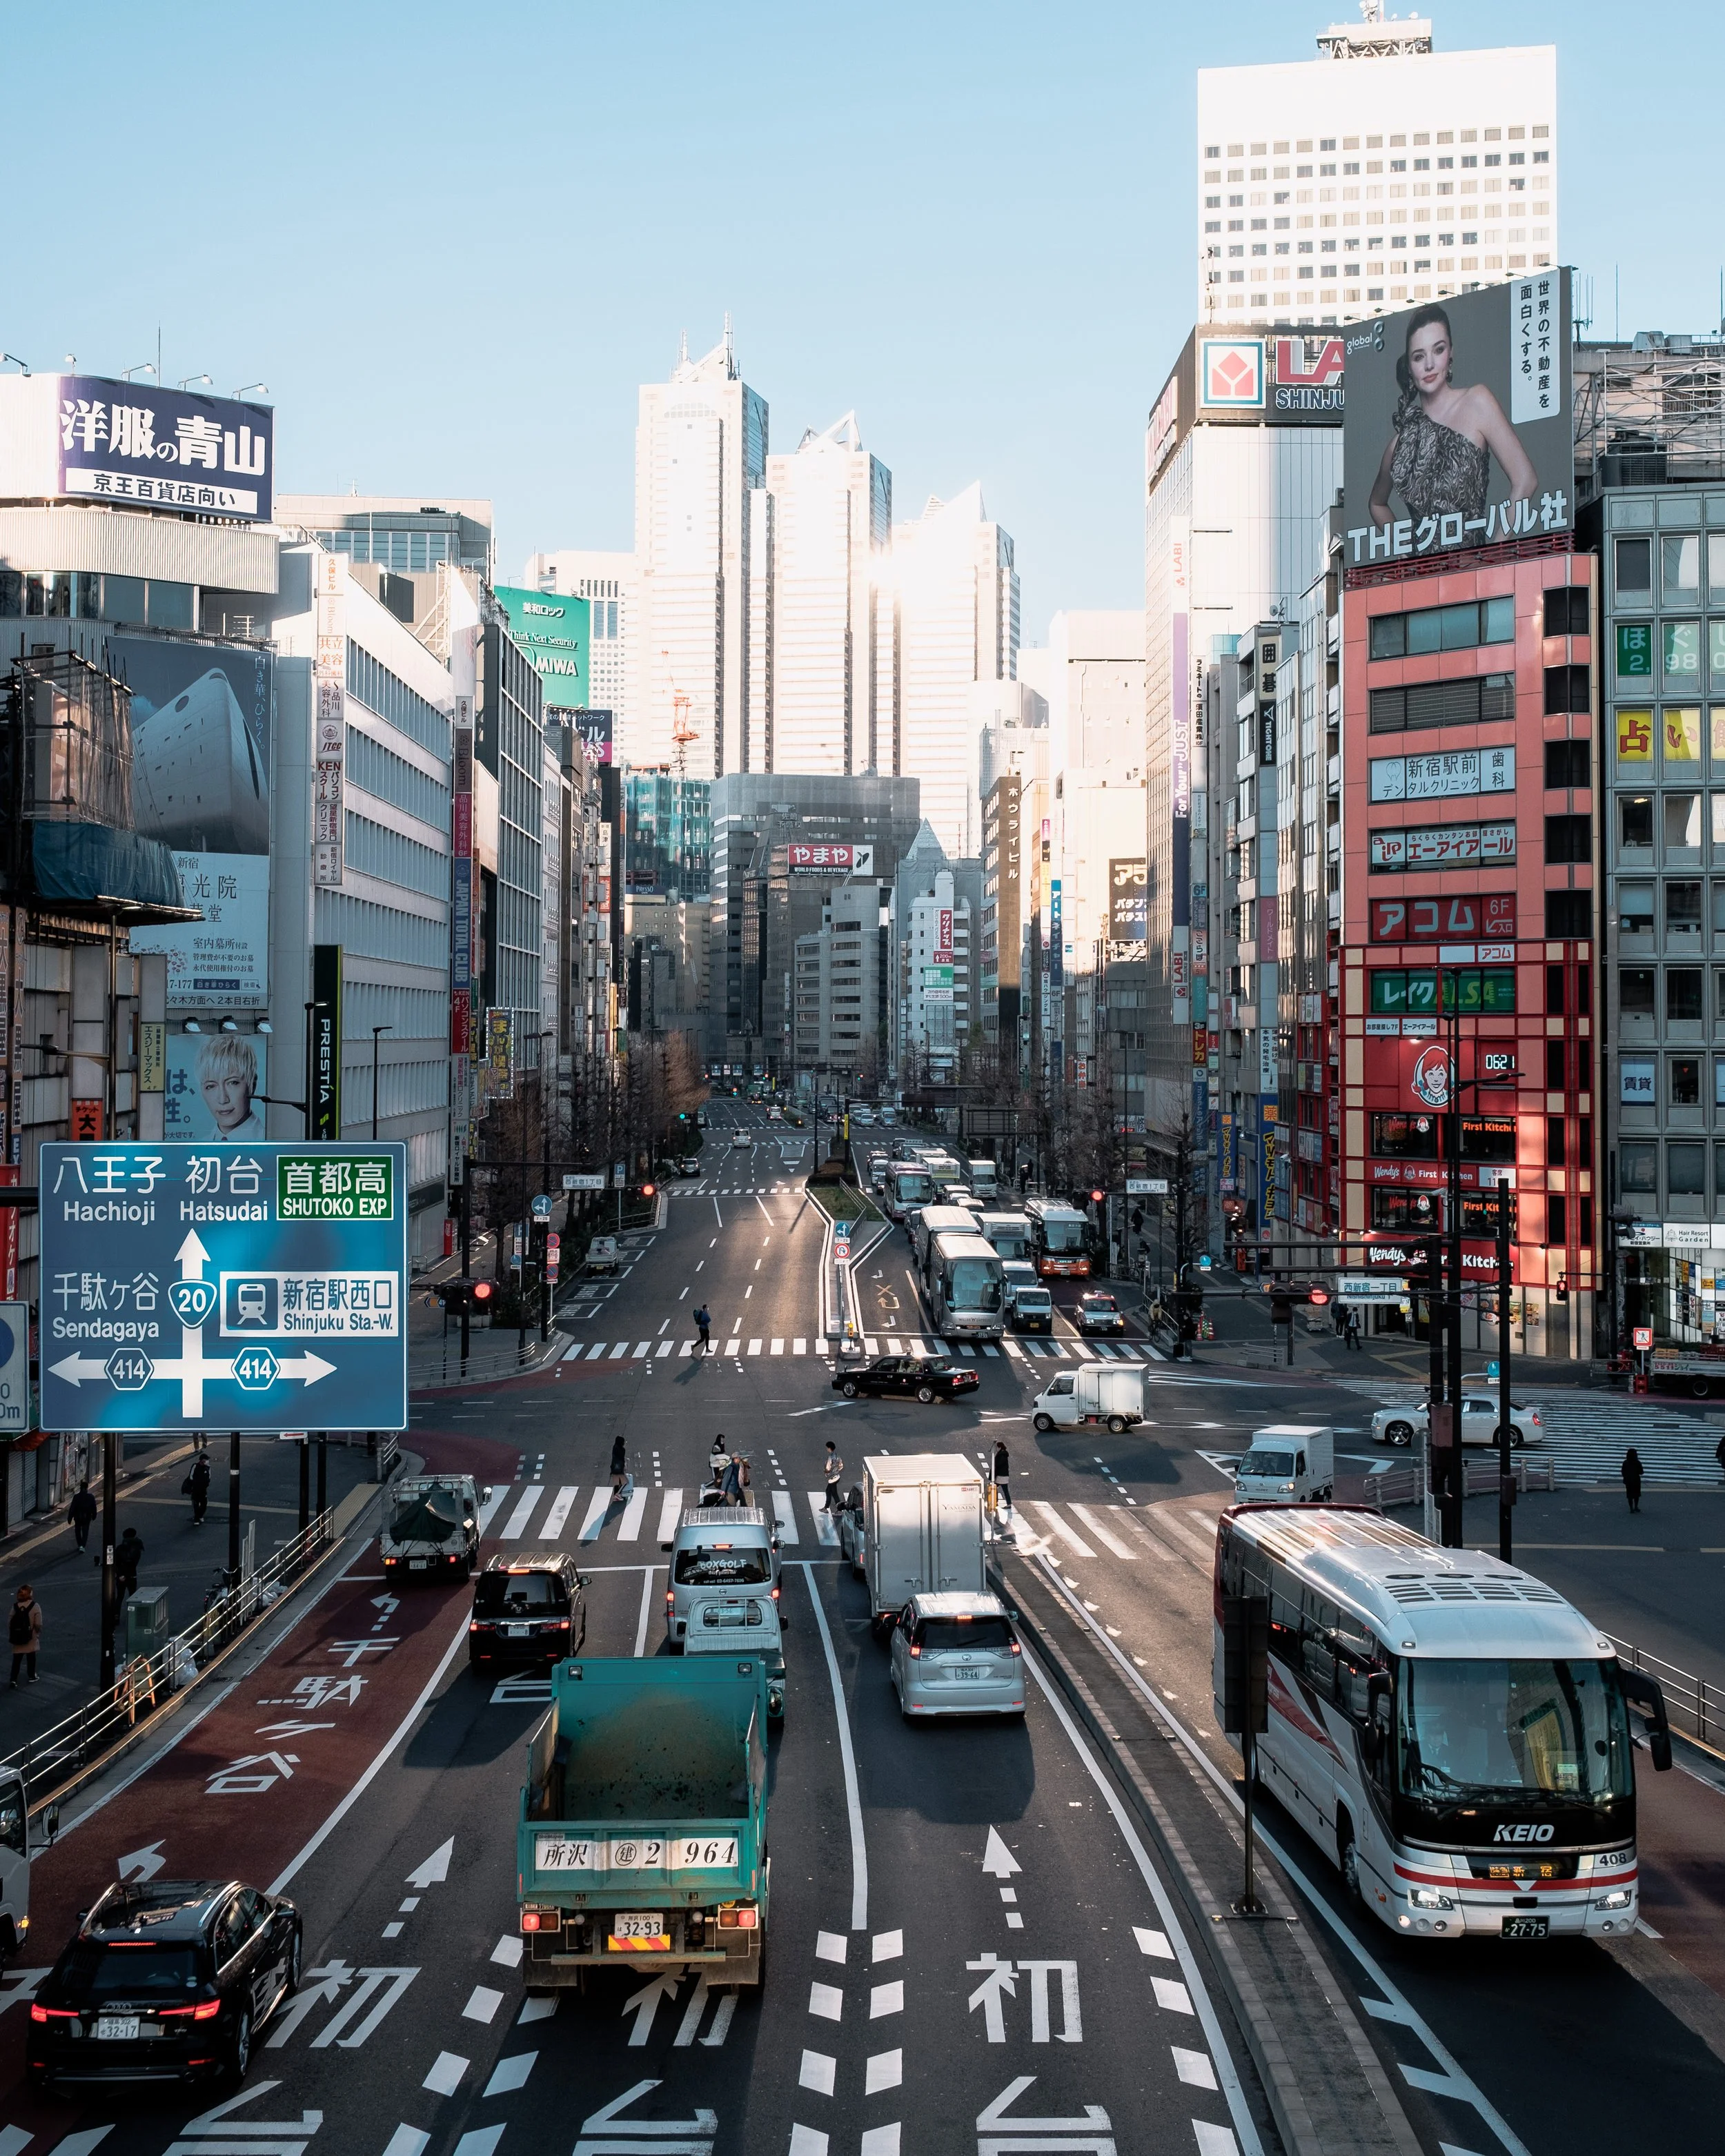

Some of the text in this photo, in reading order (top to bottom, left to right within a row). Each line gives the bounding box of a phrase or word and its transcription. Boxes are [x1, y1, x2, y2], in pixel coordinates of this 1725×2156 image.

[1347, 333, 1373, 355] global
[1519, 284, 1533, 382] 面白くする。
[1537, 279, 1551, 409] 世界の不動産を
[59, 399, 266, 477] 洋服の青山
[94, 473, 236, 507] 京王百貨店向い
[1347, 489, 1568, 563] THEグローバル社
[328, 558, 336, 591] 久保ビル
[522, 602, 564, 618] 美和ロック
[531, 633, 547, 644] Next
[548, 635, 578, 649] Security
[535, 656, 579, 676] MIWA
[253, 655, 266, 751] 白き華、ひらく。
[460, 700, 468, 724] 久保ビル
[1174, 720, 1187, 760] JUST
[318, 762, 341, 771] KEN
[458, 748, 469, 787] Bloom
[1408, 753, 1477, 779] 新宿駅前
[1491, 751, 1505, 788] 歯科
[319, 771, 328, 800] スクール
[1174, 769, 1187, 819] For Your
[1382, 776, 1480, 798] デンタルクリニック
[457, 794, 469, 849] 品川美容外科
[457, 849, 469, 857] 6F
[793, 847, 849, 864] やまや
[1408, 836, 1513, 860] エーアイアール
[177, 856, 199, 870] 新宿
[1193, 884, 1206, 896] 6F
[1114, 911, 1147, 922] パチス
[1379, 899, 1475, 936] アコム
[1490, 899, 1509, 915] 6F
[455, 880, 469, 982] JAPAN TOTAL CLUB
[1052, 891, 1061, 970] アートネイチャー
[1498, 922, 1513, 933] 入口
[193, 937, 248, 950] 室内墓所付設
[1481, 947, 1511, 960] アコム
[193, 953, 255, 962] 管理費が不要のお墓
[193, 964, 254, 972] 永代使用権付のお墓
[1174, 952, 1183, 983] LABI
[217, 996, 260, 1005] 2本目右折
[460, 997, 469, 1053] パソコンスクール
[1193, 1022, 1205, 1030] 3F
[144, 1026, 153, 1084] エスジーマックス
[1194, 1030, 1205, 1062] トレカ
[319, 1018, 335, 1104] PRESTÍA
[1624, 1076, 1653, 1091] 賃貸
[75, 1105, 99, 1114] チケット
[1264, 1105, 1277, 1120] 薬
[52, 1155, 264, 1195] 八王子 初台
[284, 1161, 387, 1196] 首都高
[1374, 1165, 1437, 1179] Wendy's First
[63, 1200, 268, 1225] Hachioji Hatsudai
[283, 1196, 387, 1216] SHUTOKO EXP
[283, 1278, 392, 1310] 新宿駅西口
[1343, 1282, 1397, 1292] 西新宿一丁目
[178, 1289, 207, 1313] 20
[52, 1317, 159, 1342] Sendagaya
[283, 1313, 393, 1333] Shinjuku Sta.-W.
[112, 1358, 146, 1378] 414
[239, 1358, 272, 1378] 414
[1493, 1824, 1555, 1842] KEIO
[542, 1843, 589, 1867] 所沢
[644, 1842, 661, 1865] 2
[1599, 1852, 1627, 1866] 408
[623, 1921, 661, 1936] 32-93
[1510, 1923, 1546, 1937] 27-75
[106, 2025, 137, 2037] 32-17
